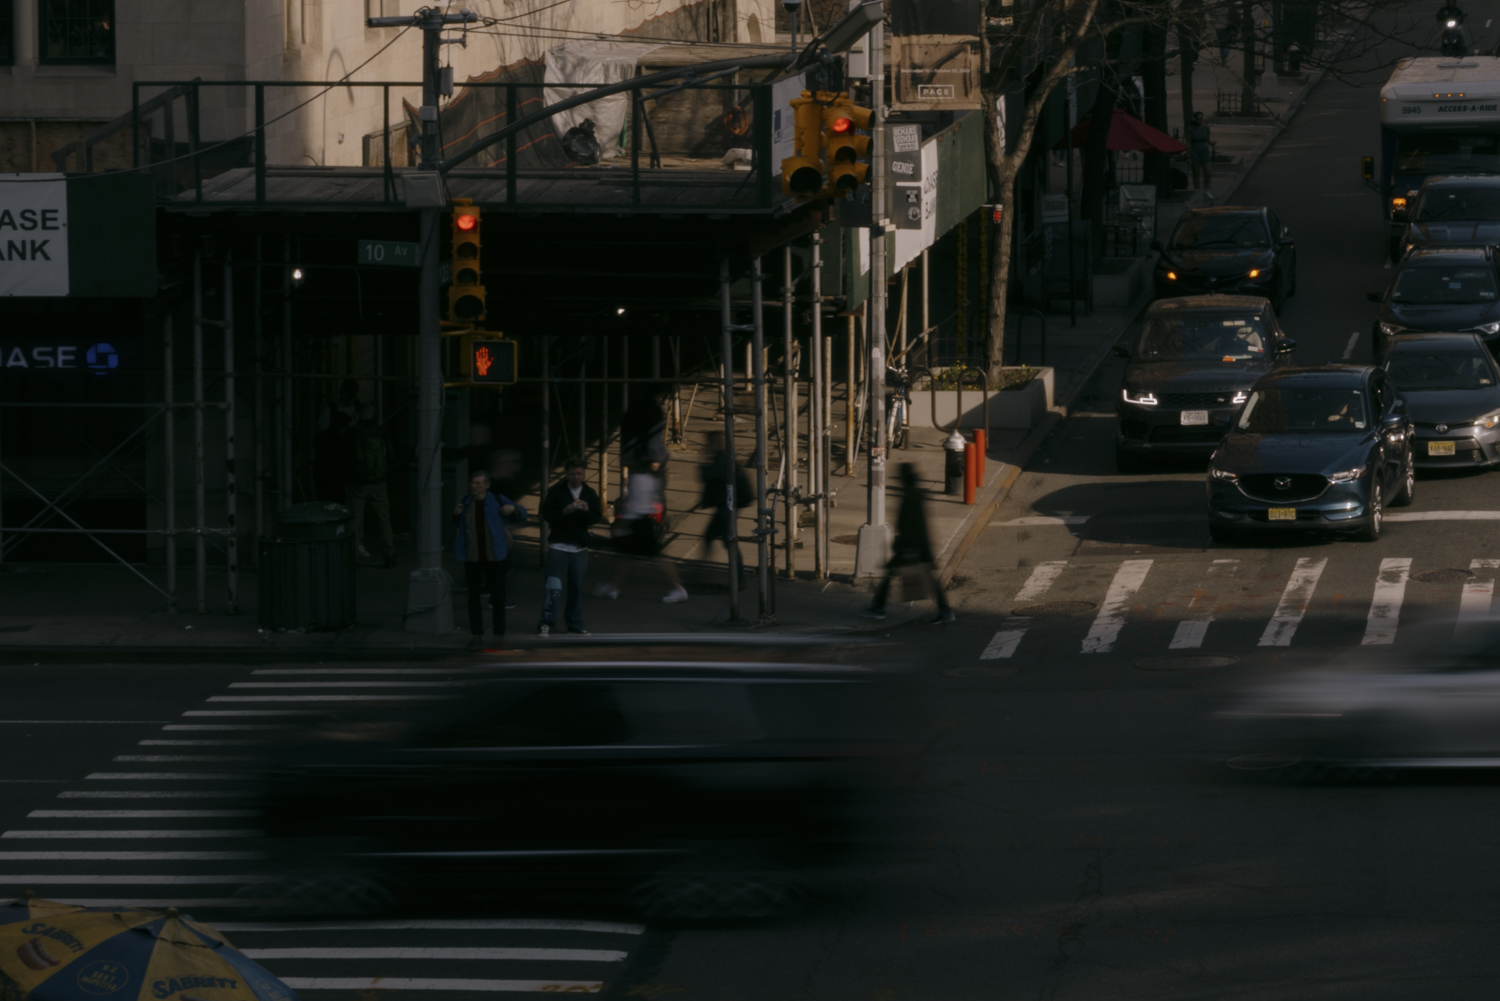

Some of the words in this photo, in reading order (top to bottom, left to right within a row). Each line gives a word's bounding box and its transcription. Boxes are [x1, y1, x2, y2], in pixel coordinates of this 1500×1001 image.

[1402, 106, 1421, 114] 5945
[1437, 104, 1498, 112] ACCESS-A-RIDE
[366, 244, 384, 261] 10
[395, 245, 408, 256] Av
[21, 922, 84, 953] SABRETT
[151, 975, 239, 1000] SABRETT
